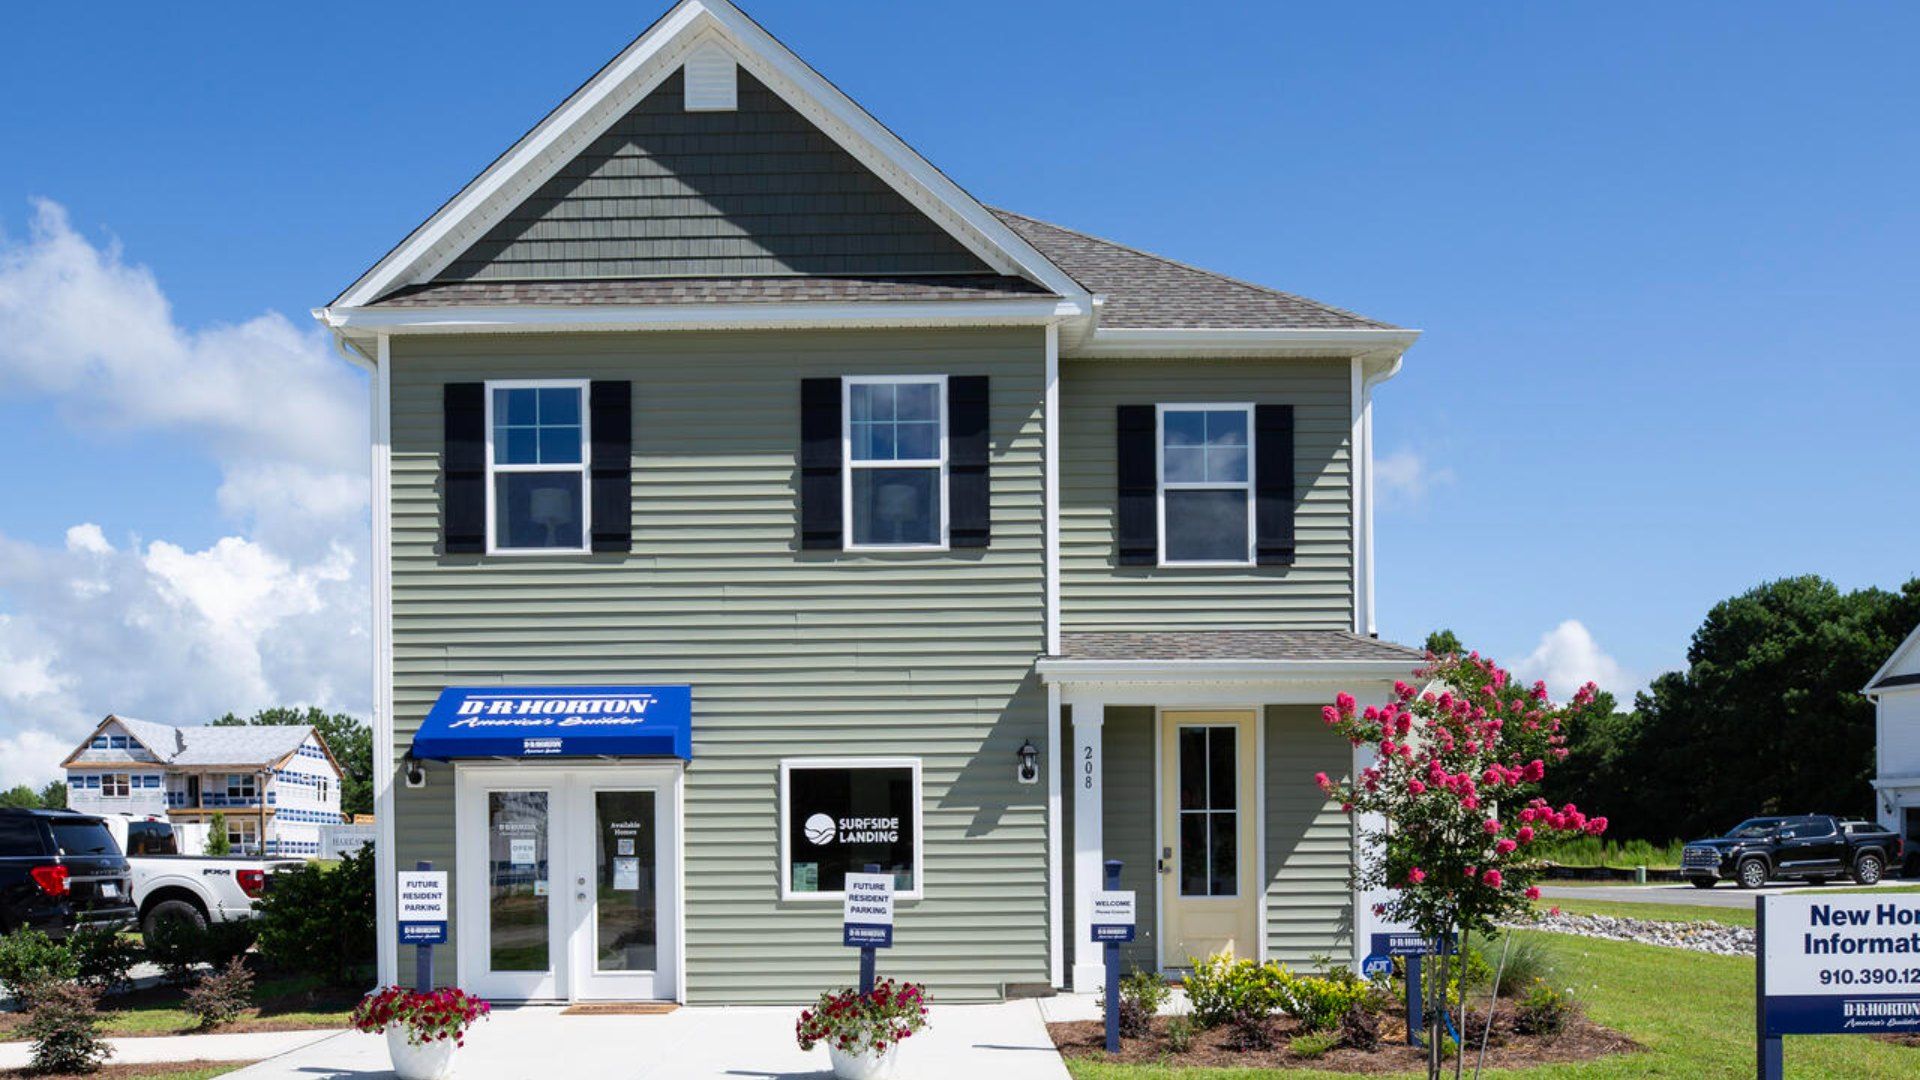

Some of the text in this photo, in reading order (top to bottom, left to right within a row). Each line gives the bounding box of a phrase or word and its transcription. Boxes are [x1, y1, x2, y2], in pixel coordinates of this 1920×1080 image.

[1084, 746, 1093, 789] 208
[839, 818, 899, 830] SURFSIDE
[839, 831, 898, 843] LANDING
[853, 883, 886, 891] FUTURE
[402, 892, 443, 900] RESIDENT
[848, 894, 889, 902] RESIDENT
[850, 905, 887, 915] PARKING
[1811, 904, 1870, 926] New
[1366, 960, 1390, 972] ADT
[1819, 967, 1920, 985] 910.390.12
